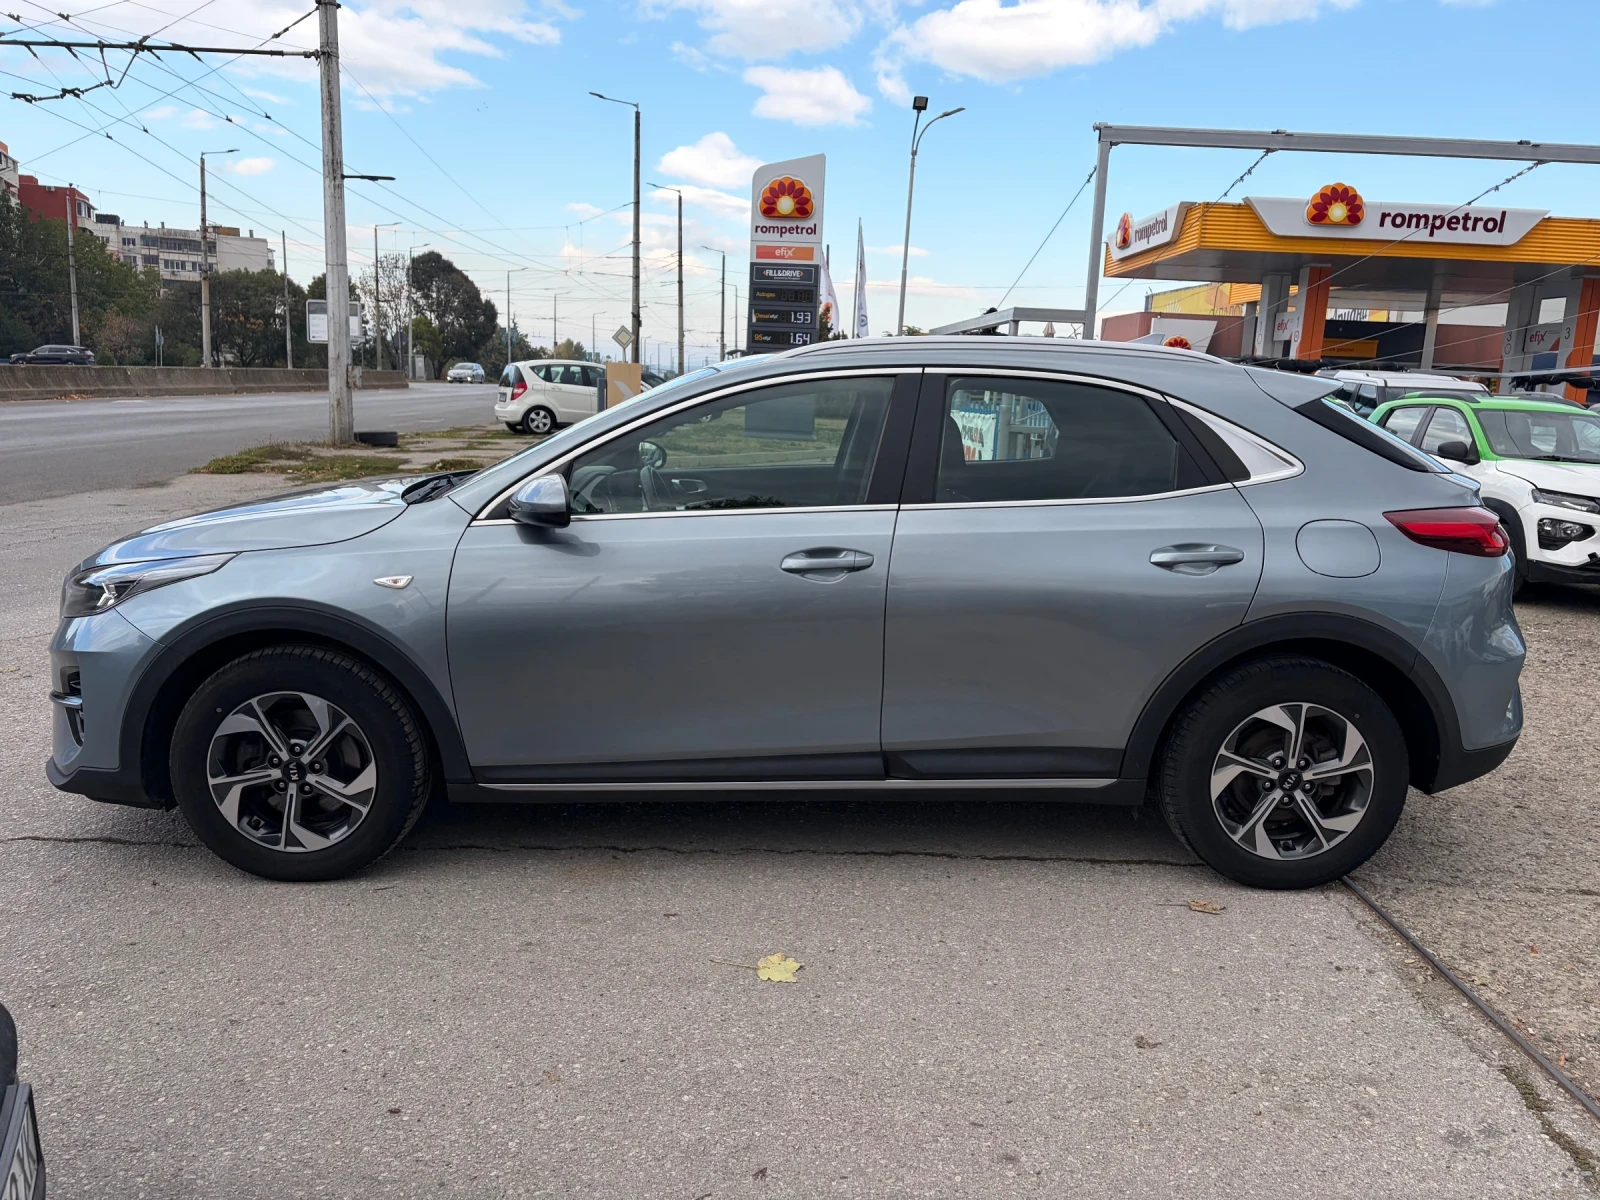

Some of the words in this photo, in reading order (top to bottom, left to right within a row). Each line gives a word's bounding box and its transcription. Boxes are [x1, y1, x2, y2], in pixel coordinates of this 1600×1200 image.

[755, 223, 816, 238] rompetrol
[1134, 209, 1168, 245] rompetrol
[1379, 210, 1506, 237] rompetrol
[775, 247, 795, 258] efix
[766, 269, 800, 277] FILL&DRIVE
[791, 312, 811, 324] 1.93
[1277, 318, 1290, 334] efix
[1564, 326, 1571, 340] 3
[754, 333, 763, 341] 95
[790, 332, 810, 345] 1.64
[1530, 330, 1547, 345] efix
[289, 762, 299, 780] KIA
[1283, 774, 1297, 789] KIA
